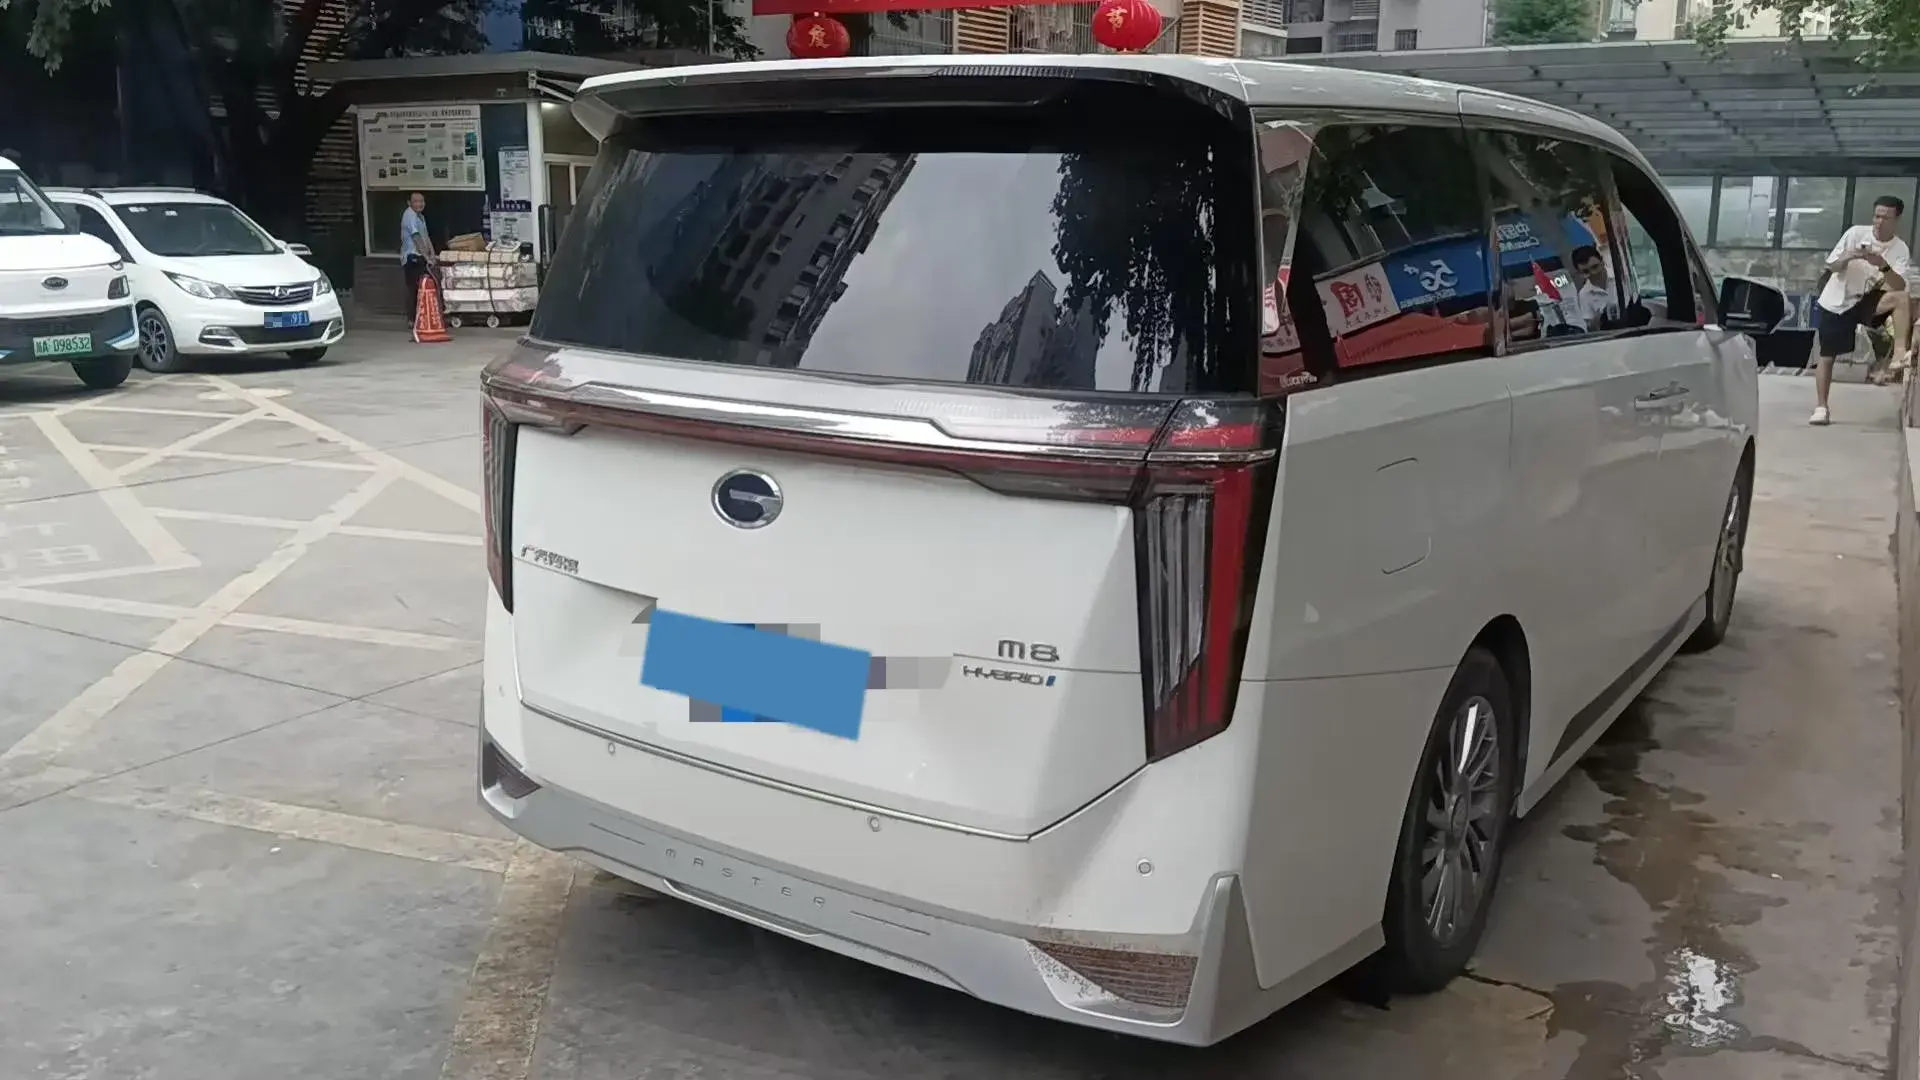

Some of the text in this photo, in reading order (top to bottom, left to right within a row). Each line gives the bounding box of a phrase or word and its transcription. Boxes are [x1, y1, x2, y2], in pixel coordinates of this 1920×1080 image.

[998, 639, 1060, 662] M8
[963, 664, 1044, 686] HYBRID
[665, 847, 827, 911] MASTER
